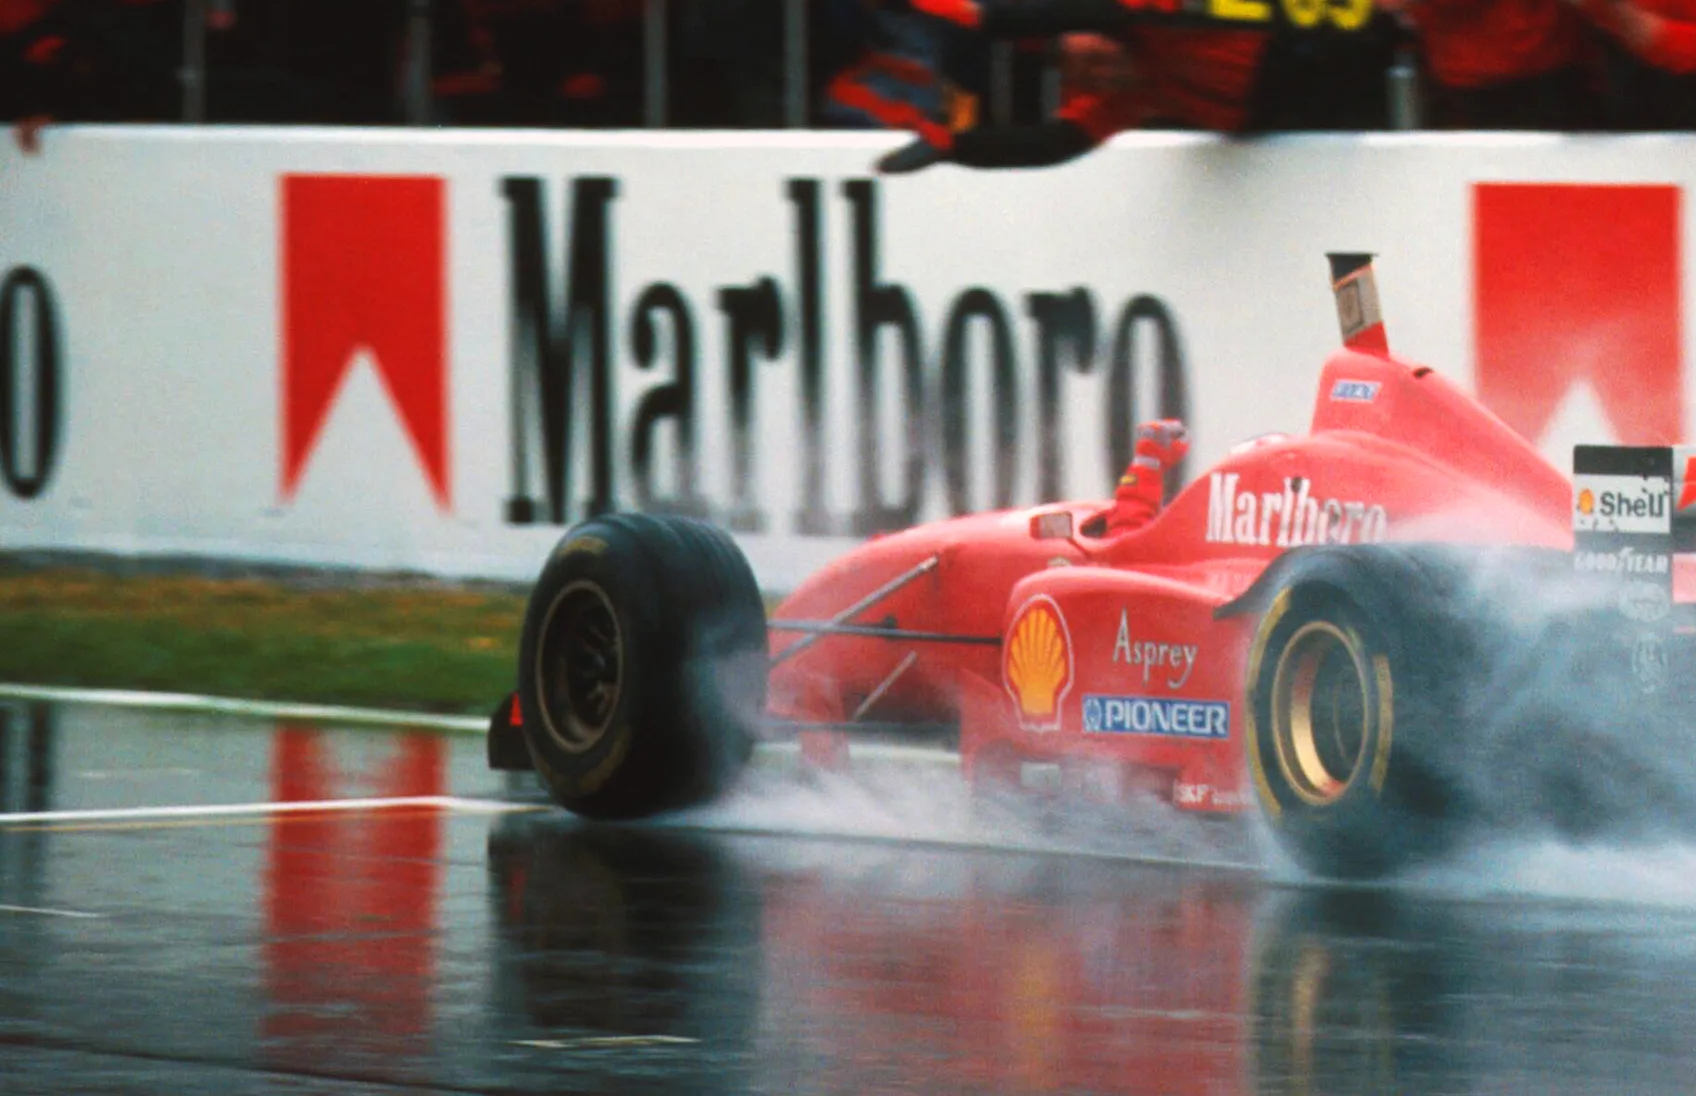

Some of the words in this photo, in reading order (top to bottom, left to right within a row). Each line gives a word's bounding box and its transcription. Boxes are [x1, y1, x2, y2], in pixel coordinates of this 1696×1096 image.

[498, 175, 1190, 538] Marlboro
[1206, 471, 1388, 547] Marlboro
[1600, 491, 1666, 518] Shell
[1111, 605, 1198, 690] Asprey
[1105, 700, 1227, 735] PIONEER
